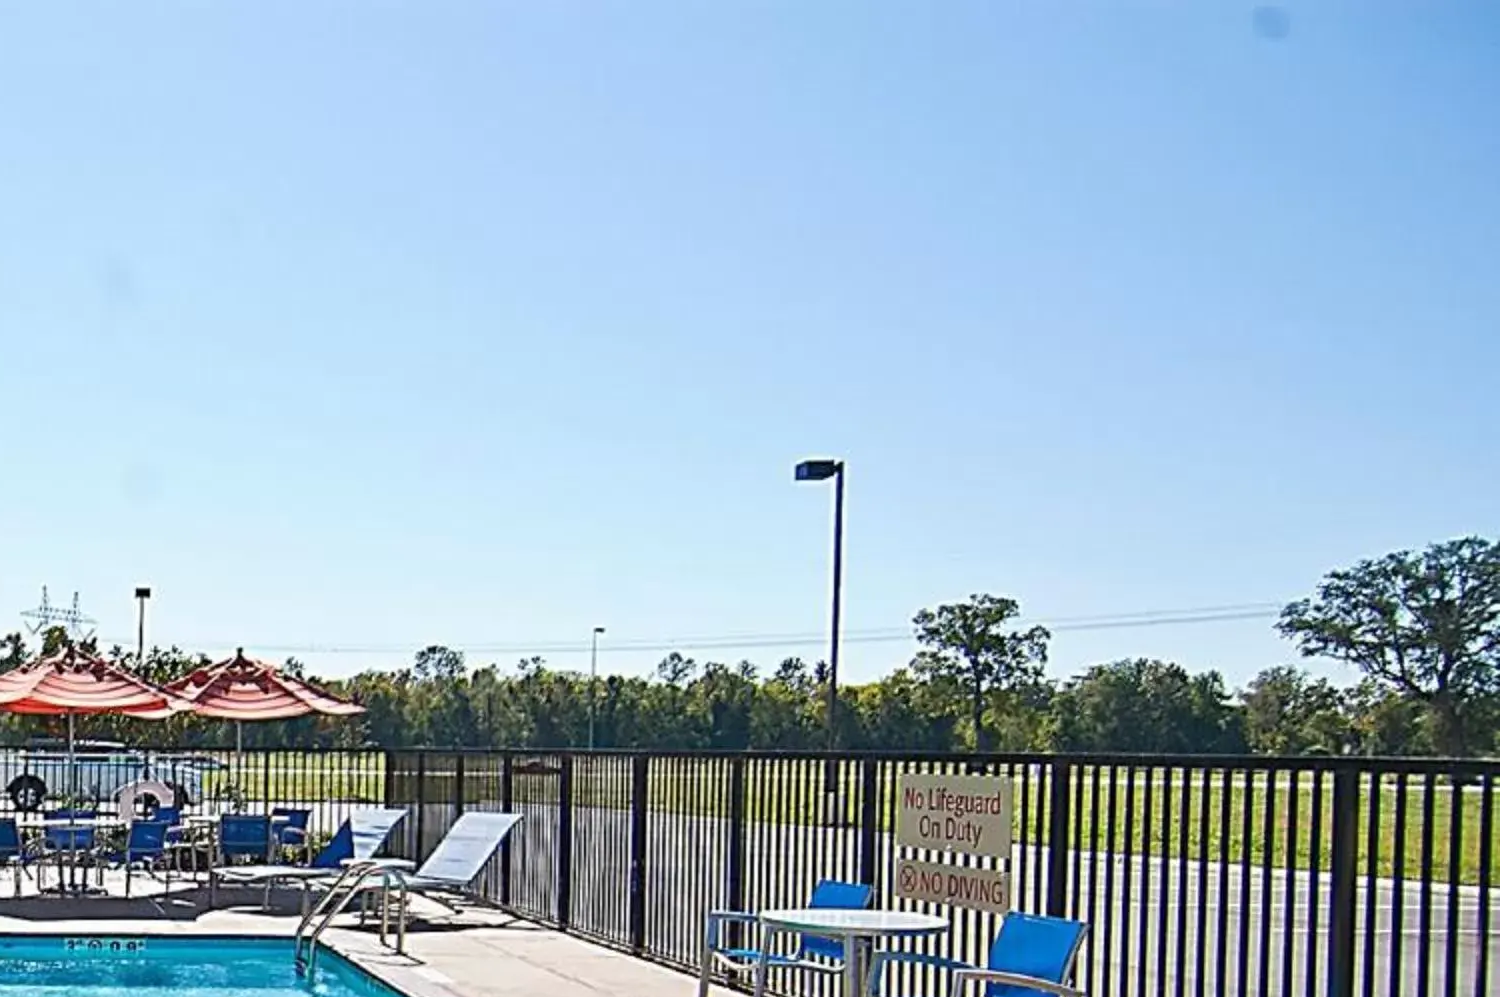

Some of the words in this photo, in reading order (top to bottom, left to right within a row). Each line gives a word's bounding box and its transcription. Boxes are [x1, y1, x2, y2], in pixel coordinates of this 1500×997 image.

[904, 787, 924, 810] No
[928, 787, 1001, 818] Lifeguard
[919, 815, 941, 838] On
[945, 817, 983, 848] Duty
[920, 871, 942, 895] NO
[947, 874, 1003, 905] DIVING
